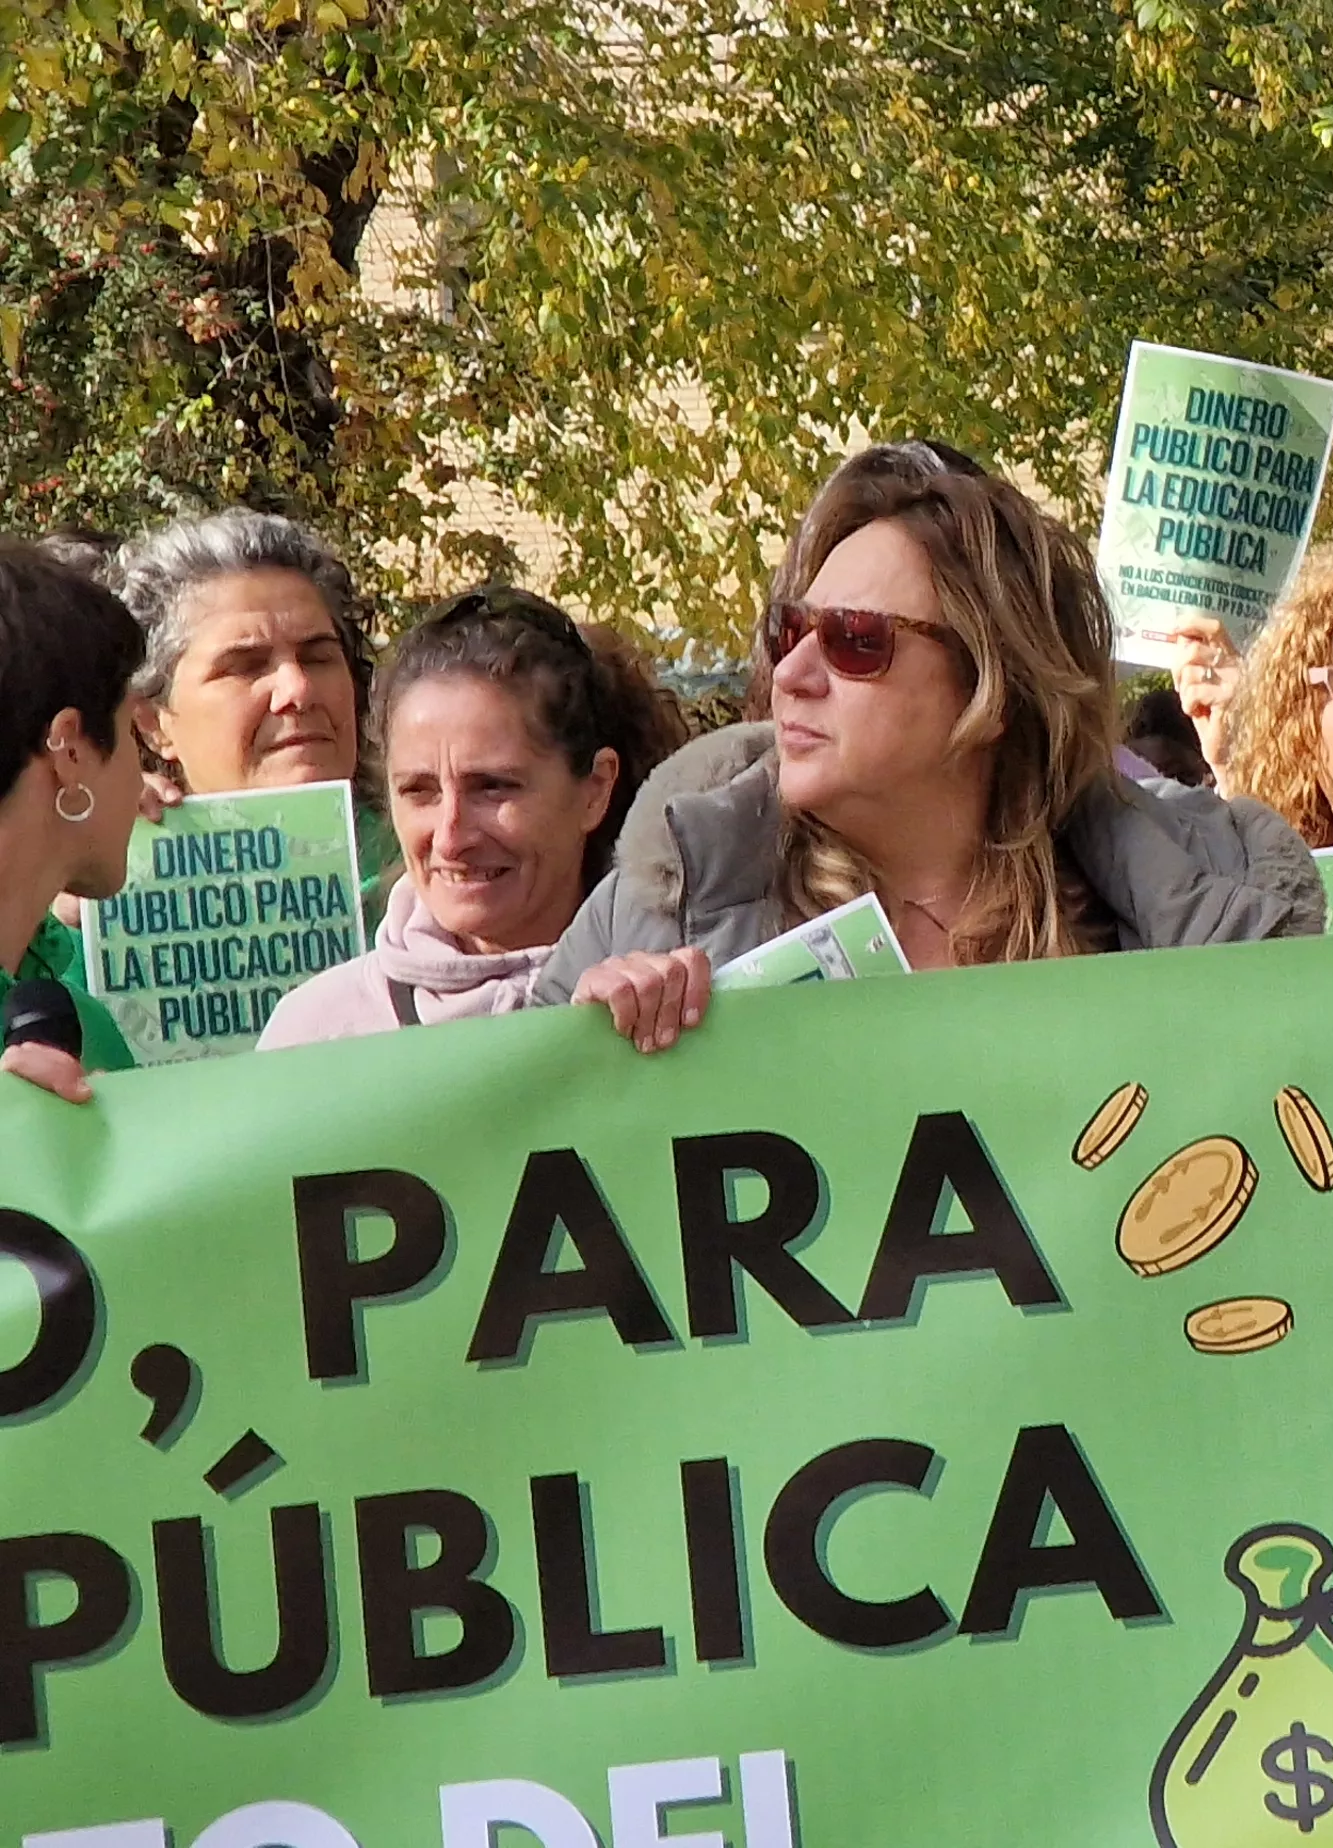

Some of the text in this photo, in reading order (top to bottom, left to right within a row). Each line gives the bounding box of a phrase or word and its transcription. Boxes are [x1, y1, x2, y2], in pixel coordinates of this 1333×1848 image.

[1185, 385, 1290, 441] DINERO
[1129, 418, 1316, 494] PÚBLICO PARA
[1121, 466, 1310, 540] LA EDUCACIÓN
[1118, 564, 1134, 579] NO
[1135, 567, 1144, 581] A
[1144, 568, 1164, 584] LOS
[1155, 507, 1269, 577] PÚBLICA
[1121, 580, 1135, 595] EN
[153, 826, 284, 881] DINERO
[99, 873, 350, 938] PÚBLICO PARA
[101, 920, 354, 993] LA EDUCACIÓN
[293, 1109, 1070, 1384] PARA
[0, 1423, 1172, 1750] PÚBLICA
